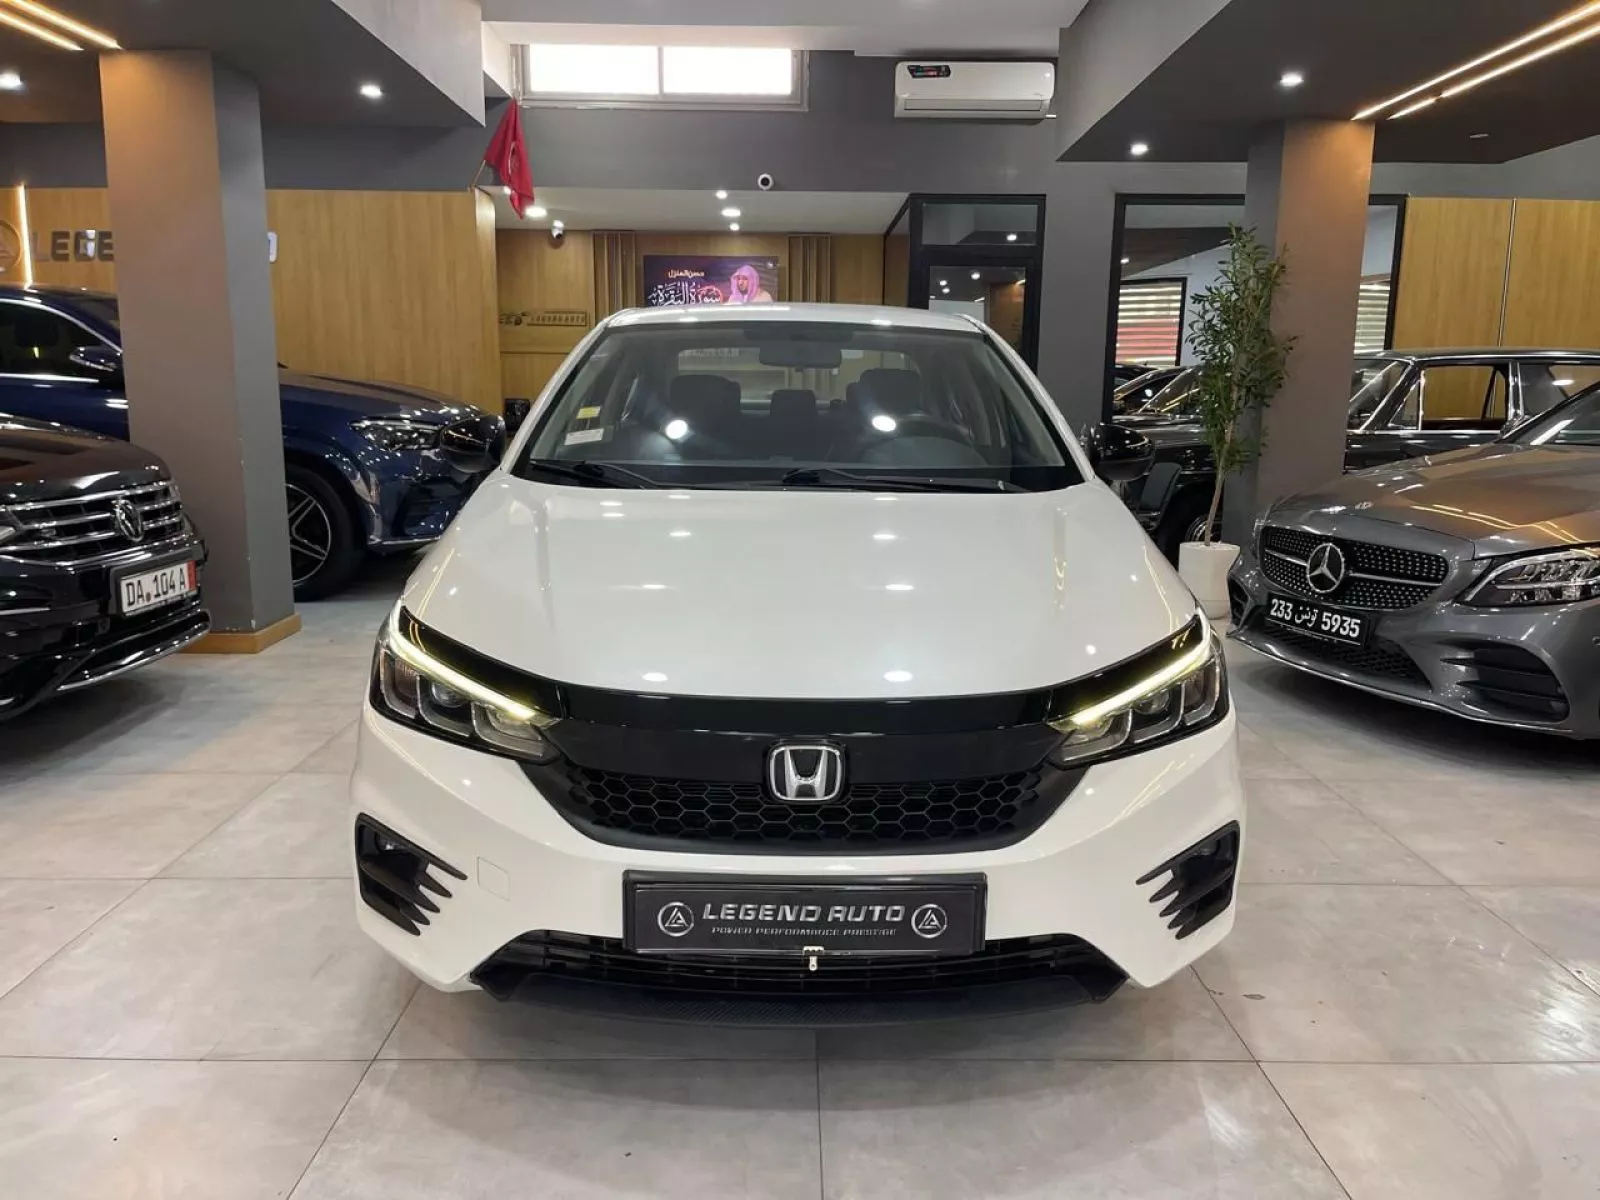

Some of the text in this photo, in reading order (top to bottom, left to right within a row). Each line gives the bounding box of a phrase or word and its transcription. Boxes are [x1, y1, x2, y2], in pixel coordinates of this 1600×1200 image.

[126, 580, 145, 606] DA
[153, 569, 176, 598] 104
[1270, 598, 1361, 637] 233 تونس 5935
[702, 903, 905, 922] LEGEND AUTO
